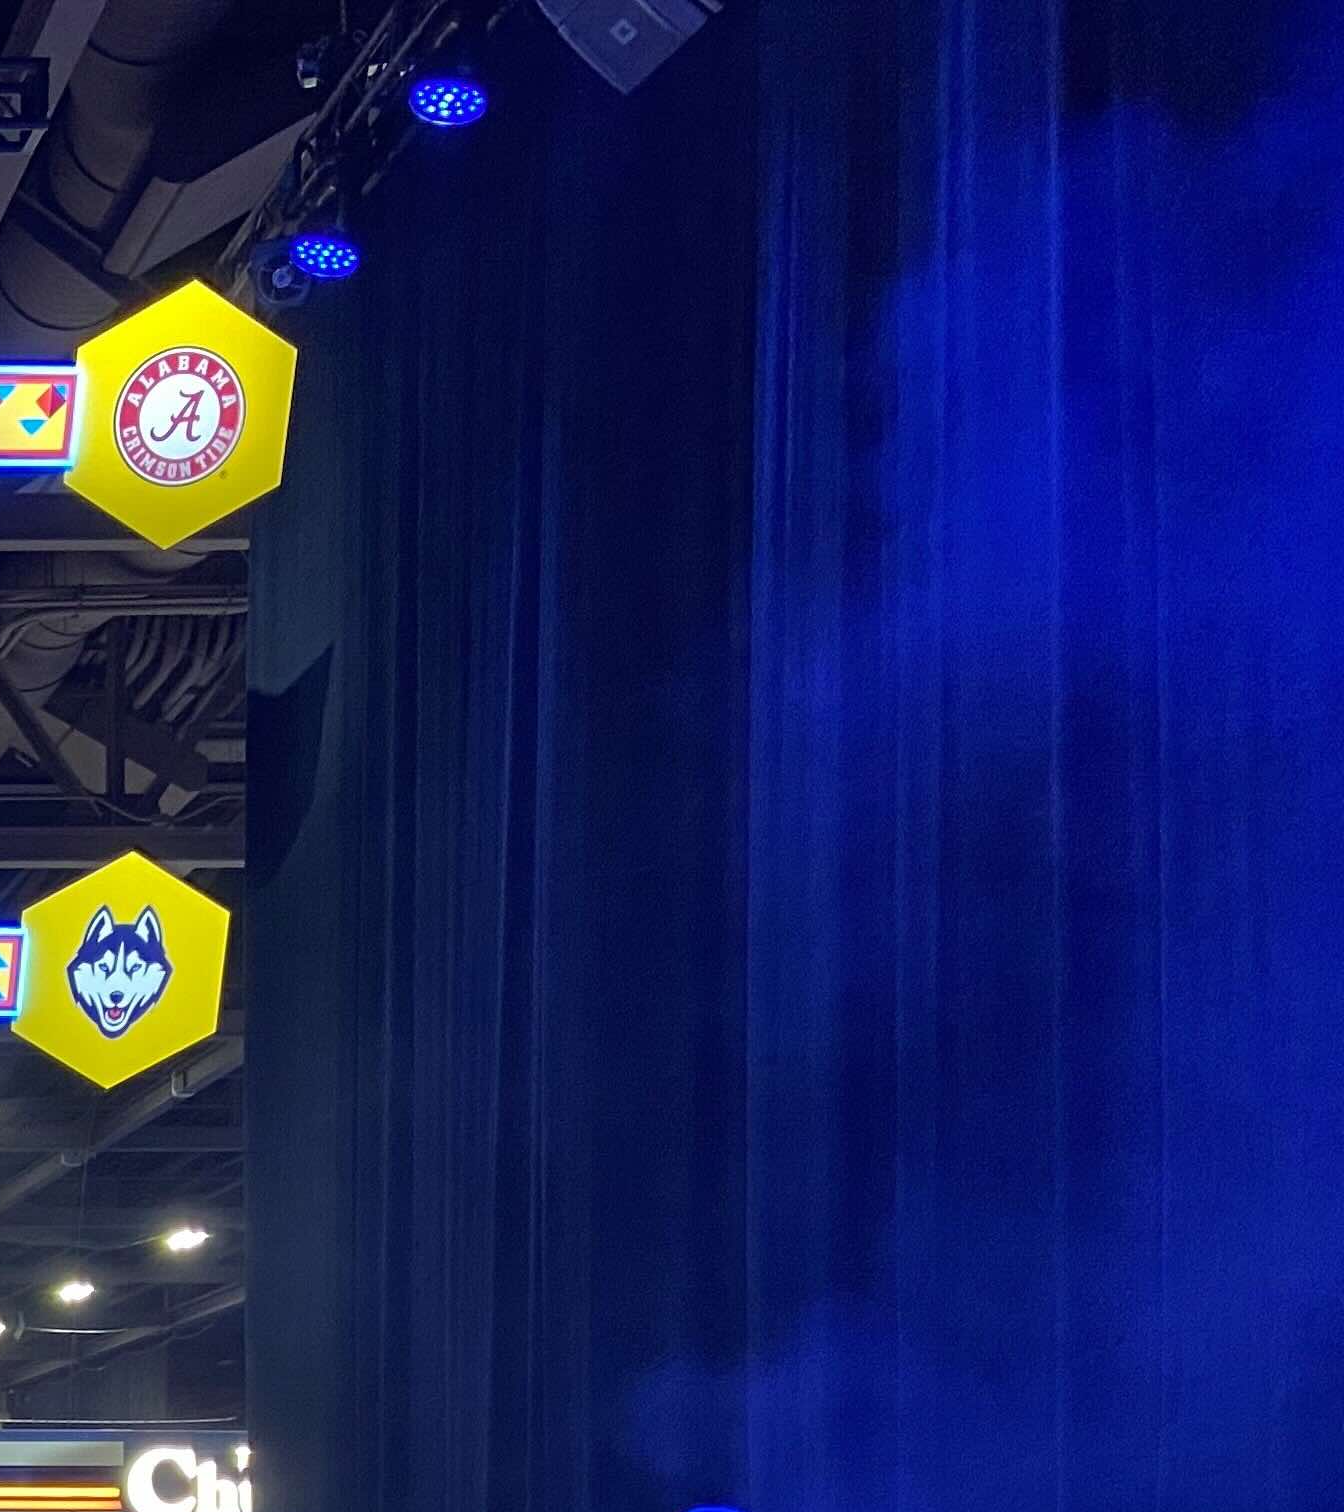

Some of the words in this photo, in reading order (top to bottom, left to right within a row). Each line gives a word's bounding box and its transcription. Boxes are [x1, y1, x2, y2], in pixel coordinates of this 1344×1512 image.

[127, 354, 238, 409] ALABAMA
[121, 425, 192, 480] CRIMSON
[194, 424, 234, 474] TIDE
